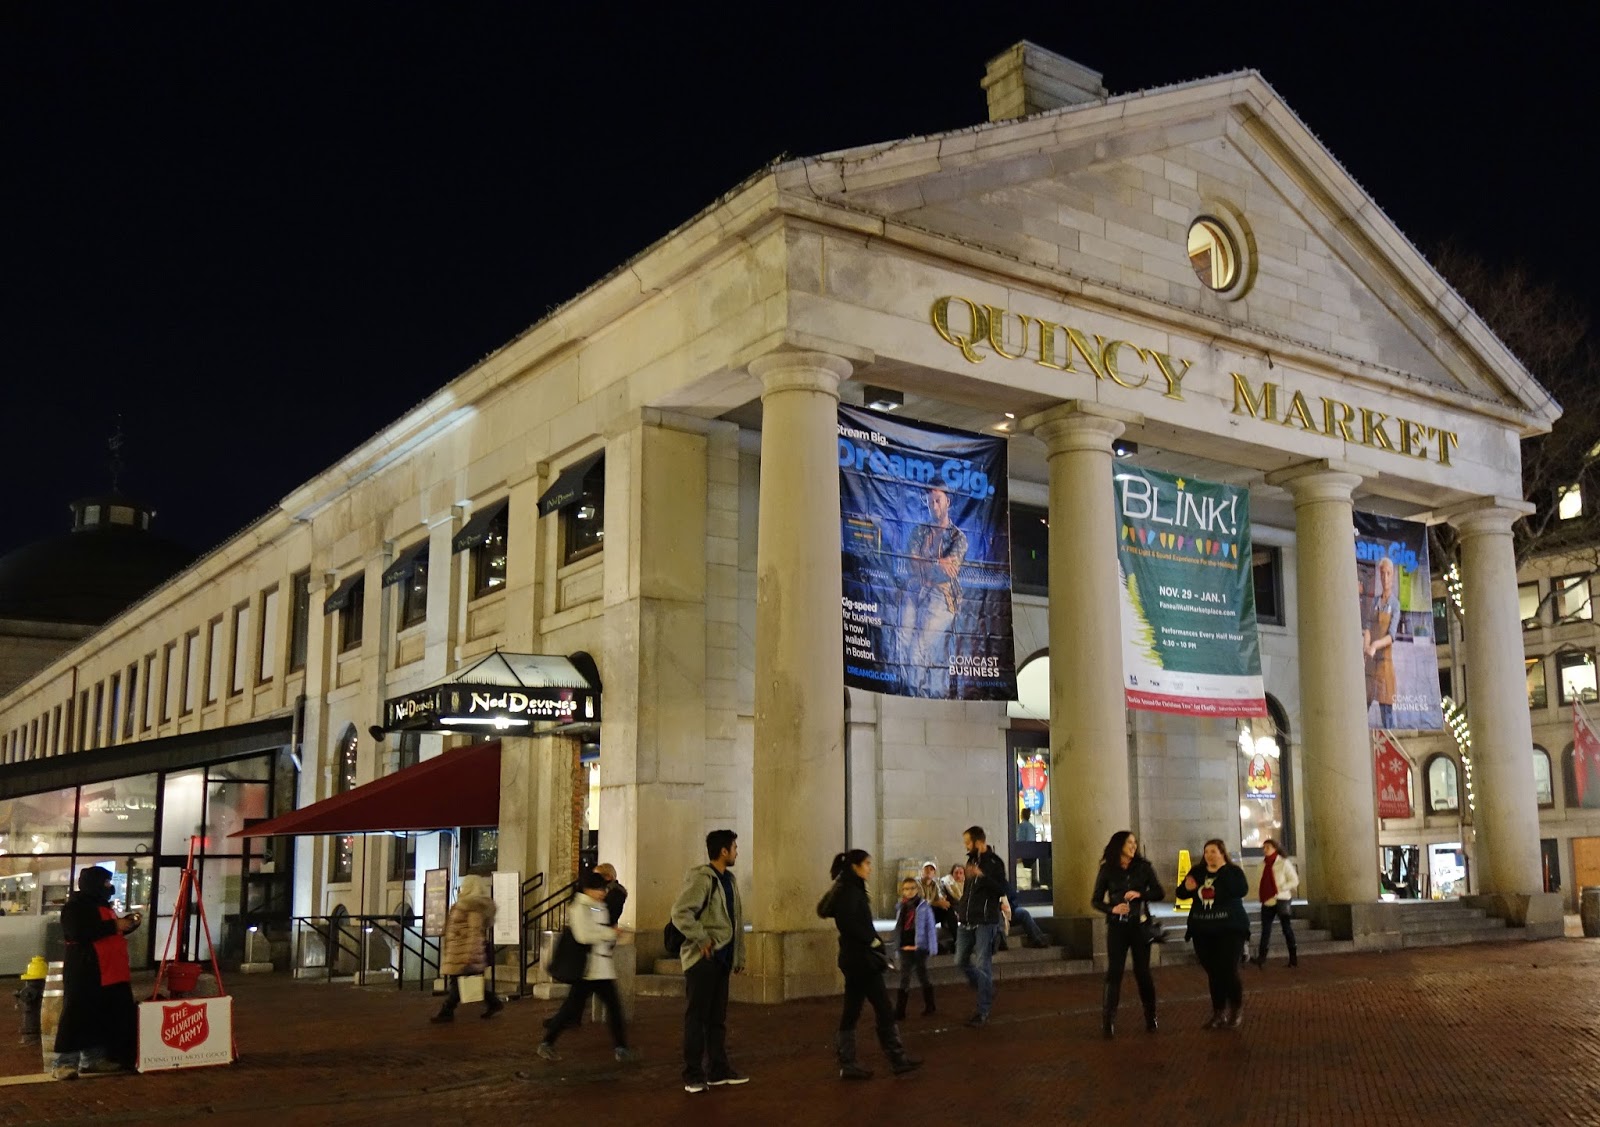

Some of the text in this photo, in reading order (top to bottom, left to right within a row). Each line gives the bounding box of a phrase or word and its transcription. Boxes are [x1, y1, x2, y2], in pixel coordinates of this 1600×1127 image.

[931, 296, 1459, 467] QUINCY MARKET
[870, 431, 889, 446] Big.
[838, 437, 996, 500] Dream Gig.
[1117, 474, 1239, 536] BLINK!
[1159, 585, 1180, 598] NOV.
[1181, 589, 1192, 600] 29
[1200, 591, 1221, 603] JAN.
[1222, 594, 1227, 604] 1
[851, 610, 882, 626] business
[849, 623, 864, 635] now
[1161, 626, 1199, 638] Performances
[1188, 642, 1197, 650] PM
[949, 654, 999, 667] COMCAST
[949, 665, 1000, 678] BUSINESS
[469, 692, 508, 713] Ned
[1391, 702, 1430, 712] BUSINESS
[170, 1007, 189, 1024] THE
[164, 1008, 204, 1041] SALVATION
[178, 1021, 203, 1047] ARMY
